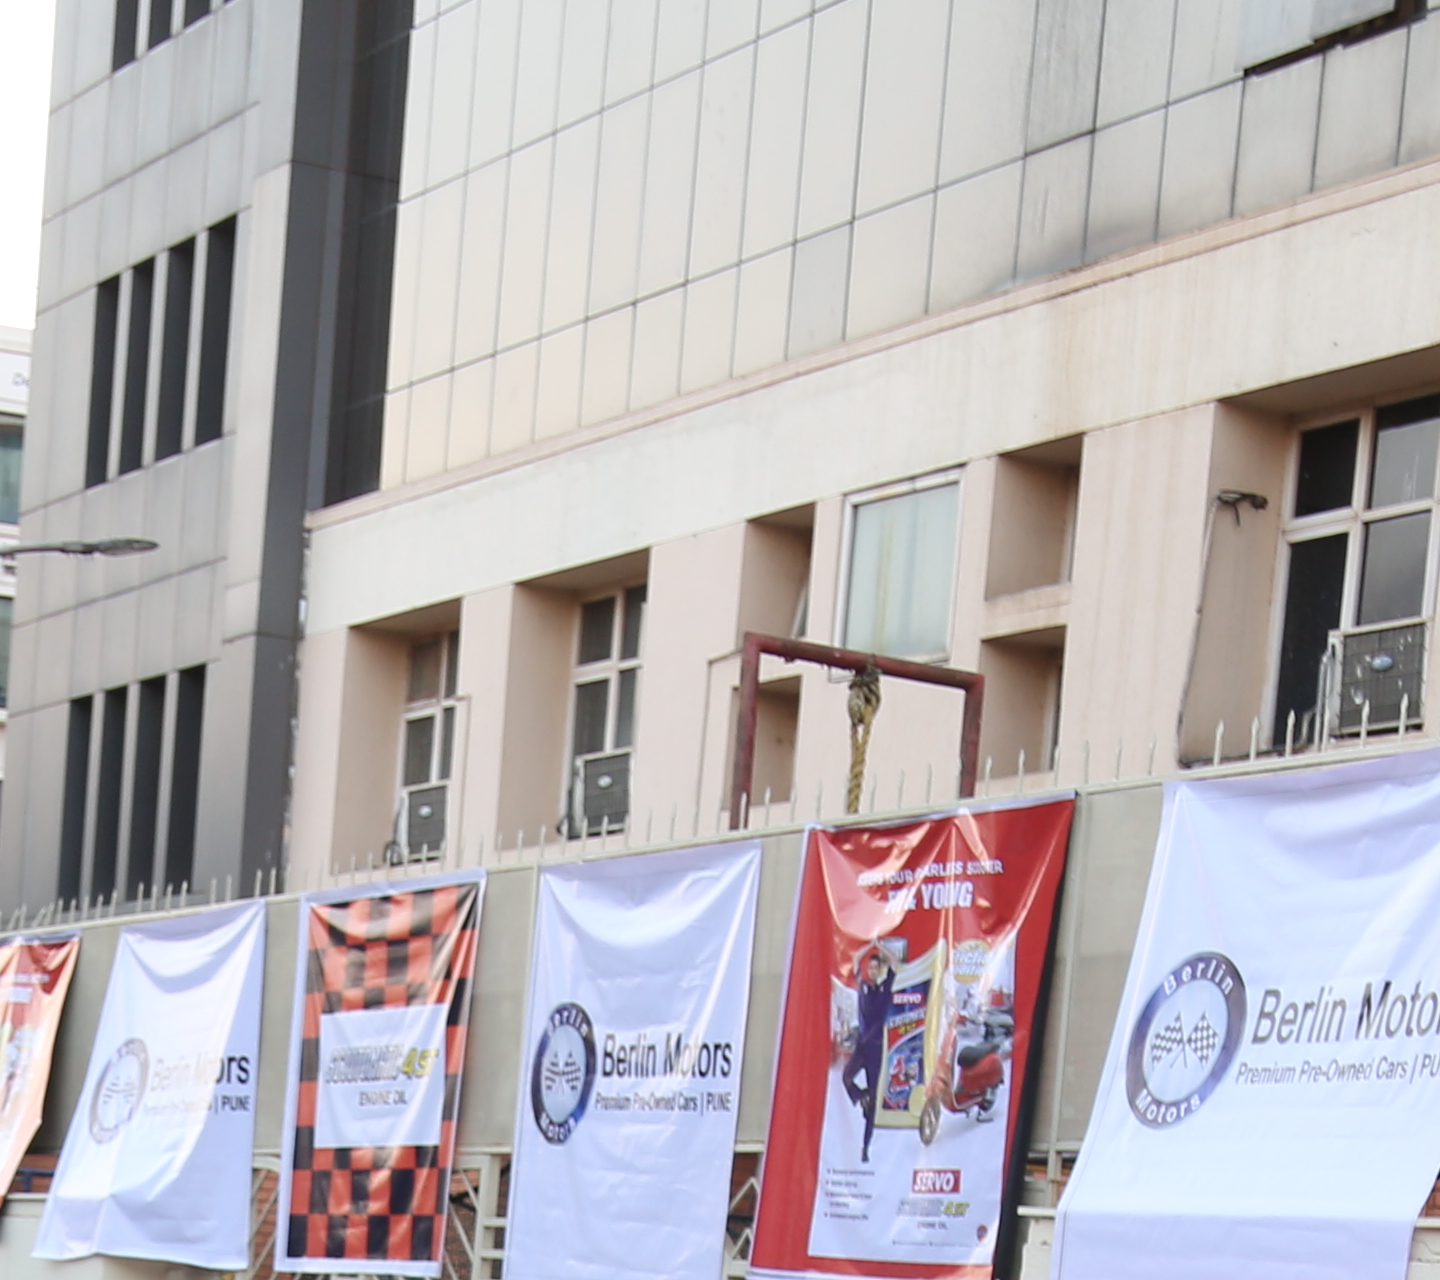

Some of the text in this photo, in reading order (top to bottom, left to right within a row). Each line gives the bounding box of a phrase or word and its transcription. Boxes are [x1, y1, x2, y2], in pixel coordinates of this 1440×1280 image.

[1163, 956, 1234, 997] Berlin
[1252, 985, 1348, 1045] Berlin
[602, 1031, 734, 1080] Berlin Motors
[1235, 1061, 1296, 1085] Premium
[1300, 1056, 1374, 1083] Pre-Owned
[1375, 1054, 1409, 1081] Cars
[914, 1171, 955, 1192] SERVO
